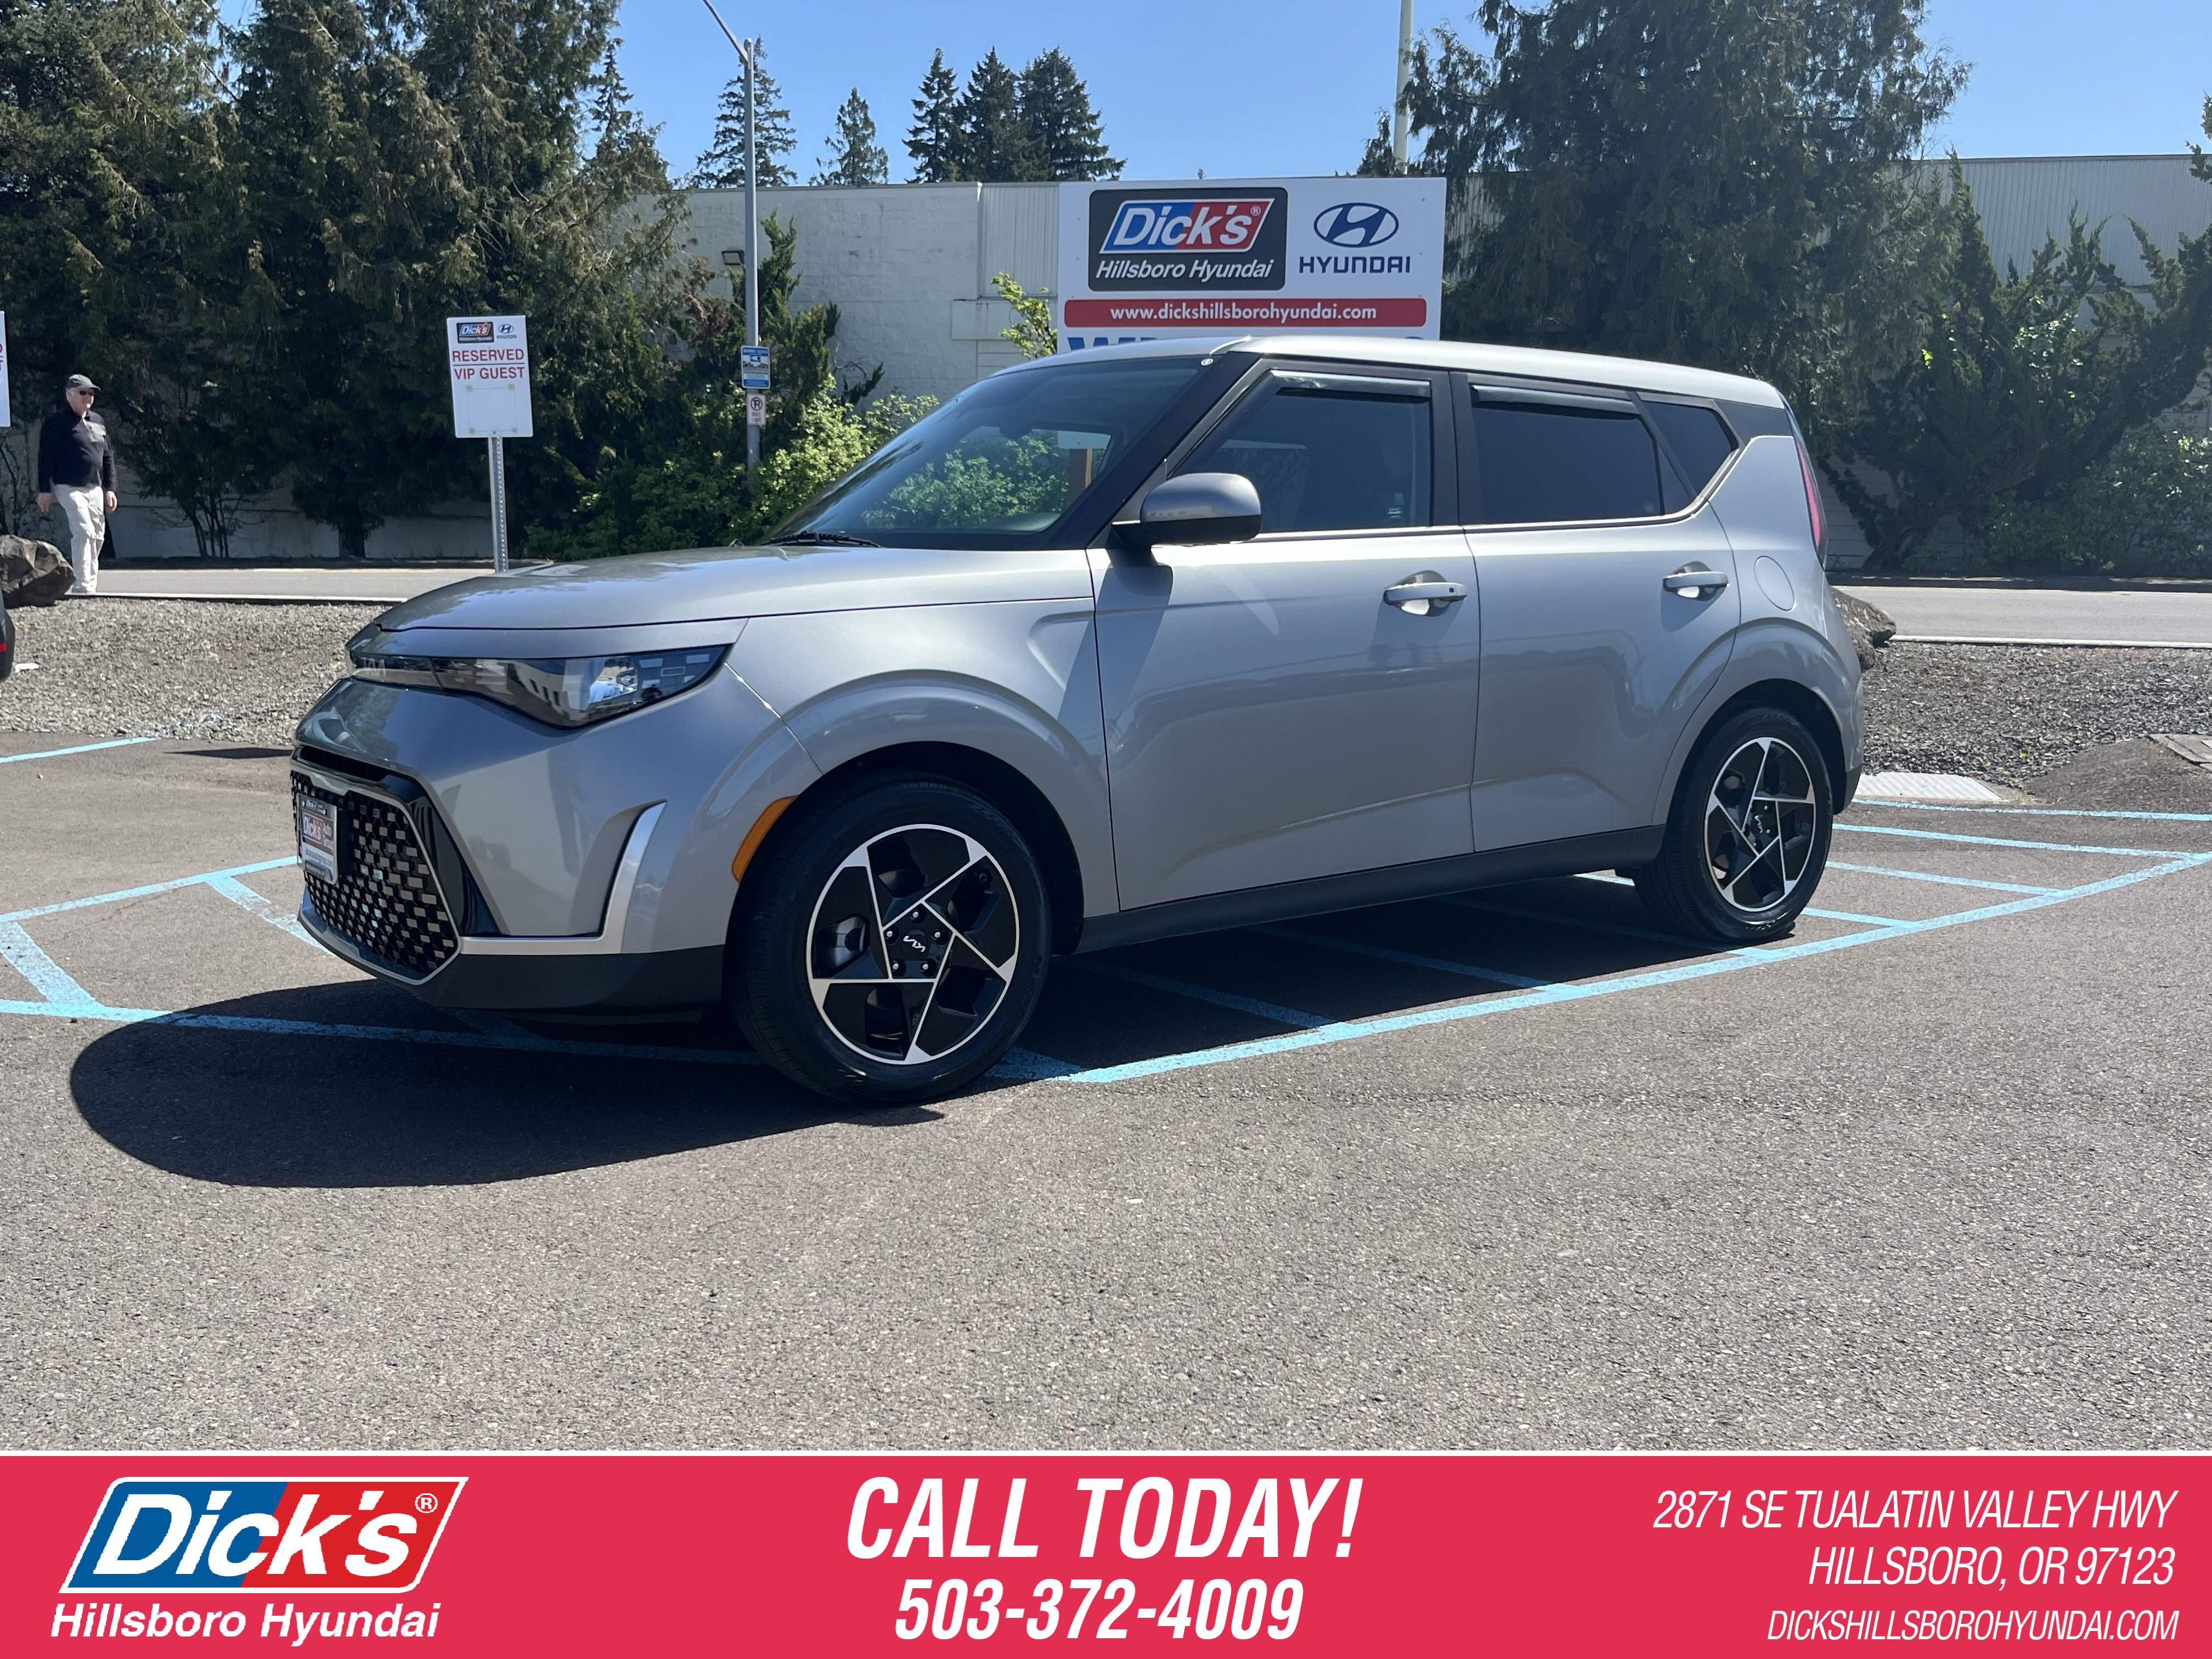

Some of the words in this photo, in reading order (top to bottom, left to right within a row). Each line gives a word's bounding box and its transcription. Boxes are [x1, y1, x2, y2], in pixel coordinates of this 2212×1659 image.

[1113, 204, 1251, 247] Dick's
[1096, 259, 1185, 279] Hillsboro
[1189, 259, 1274, 283] Hyundai
[1299, 256, 1411, 274] HYUNDAI
[1110, 302, 1377, 324] www.dickshillsborohyundai.com
[452, 348, 524, 362] RESERVED
[454, 368, 475, 380] VIP
[479, 366, 525, 379] GUEST
